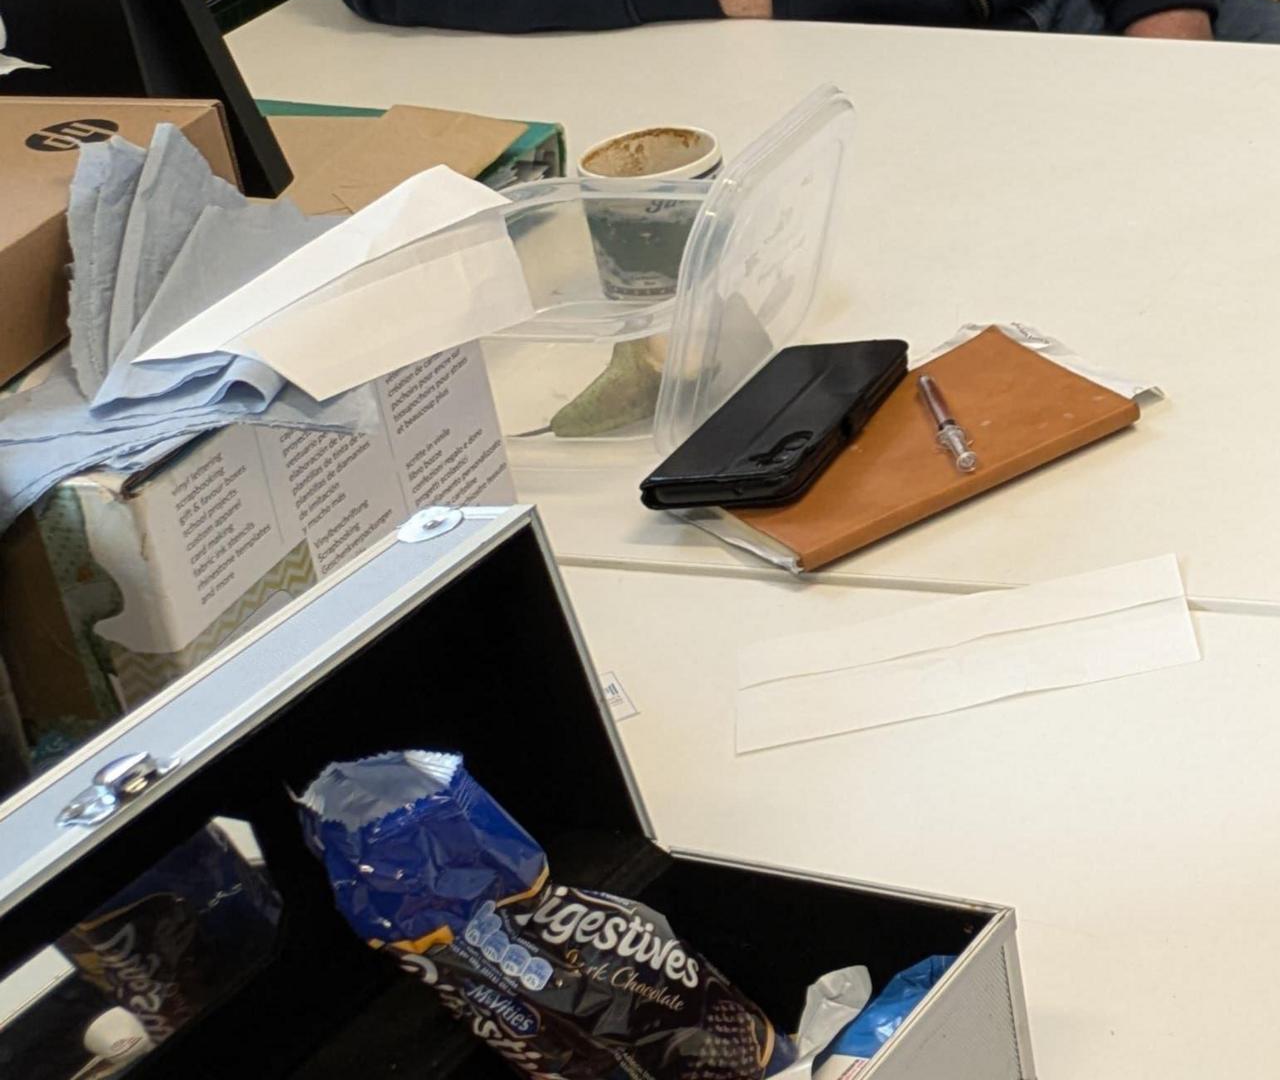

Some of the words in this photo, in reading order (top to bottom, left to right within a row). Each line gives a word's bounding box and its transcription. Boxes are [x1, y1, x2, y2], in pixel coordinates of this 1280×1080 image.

[190, 546, 207, 565] card
[201, 588, 215, 605] and
[215, 572, 235, 591] more
[513, 885, 700, 989] igestives
[609, 965, 686, 1013] Chocolate
